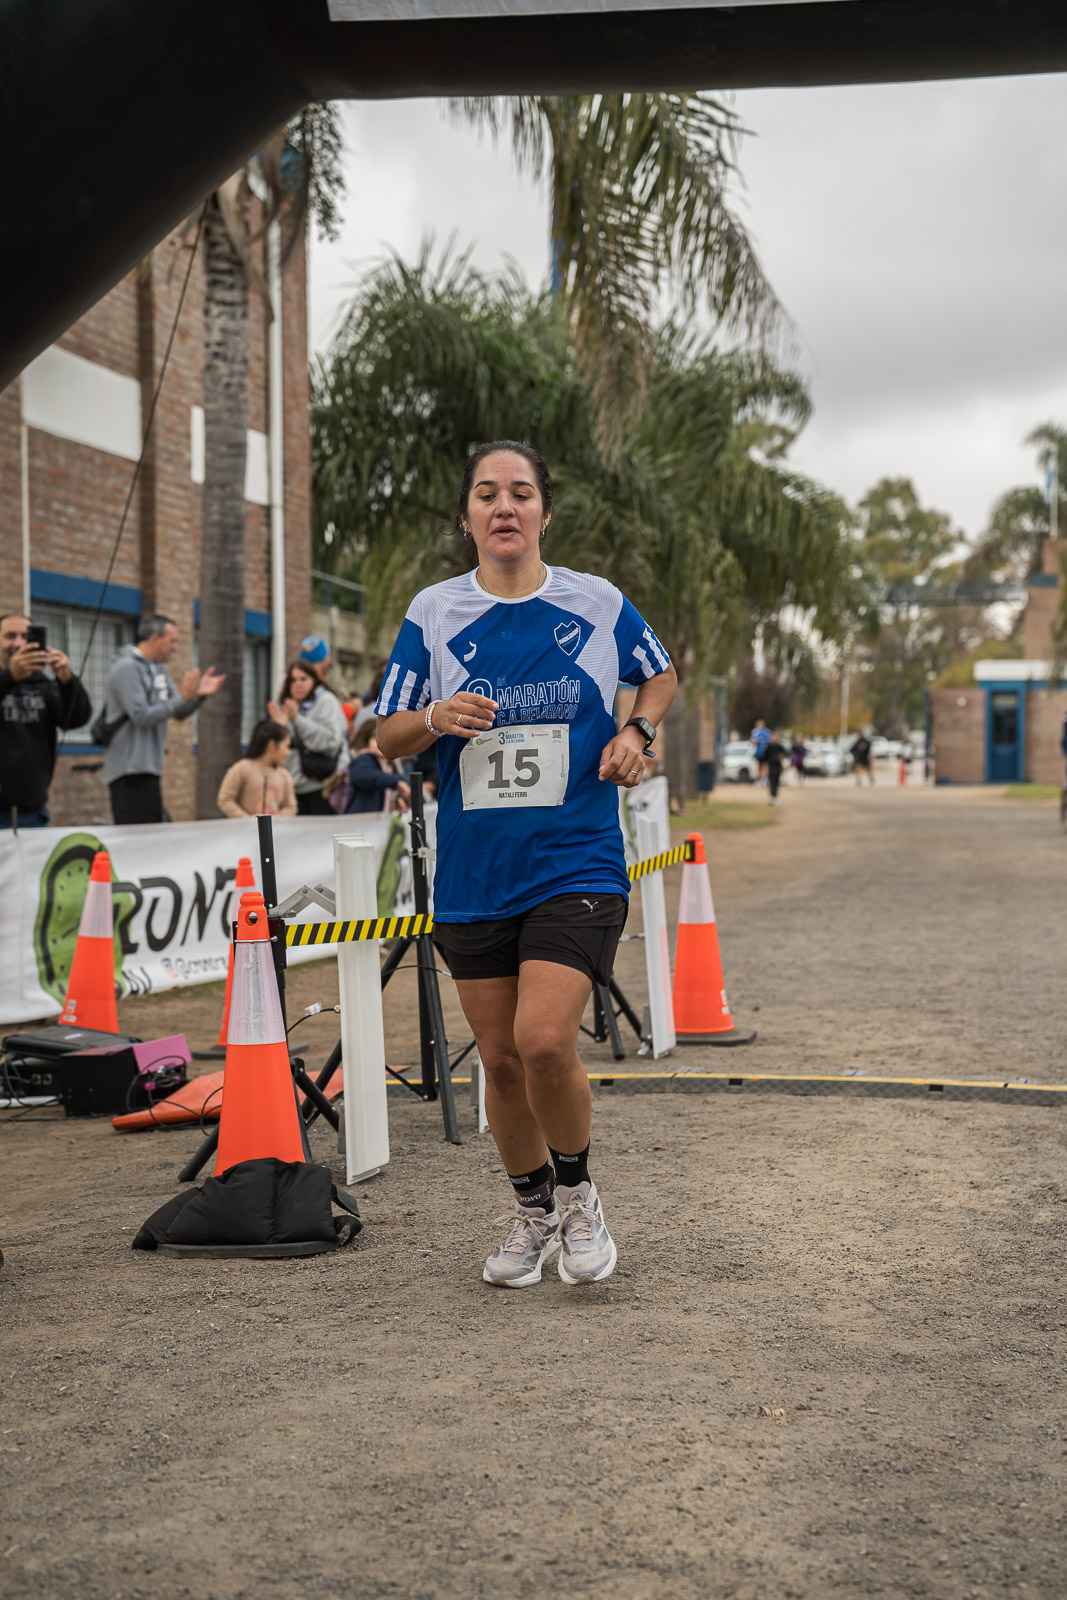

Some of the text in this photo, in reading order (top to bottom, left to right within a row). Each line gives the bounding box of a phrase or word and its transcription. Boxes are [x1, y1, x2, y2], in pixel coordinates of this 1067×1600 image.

[496, 675, 580, 710] MARATÓN
[498, 731, 506, 745] 3
[487, 748, 541, 789] 15
